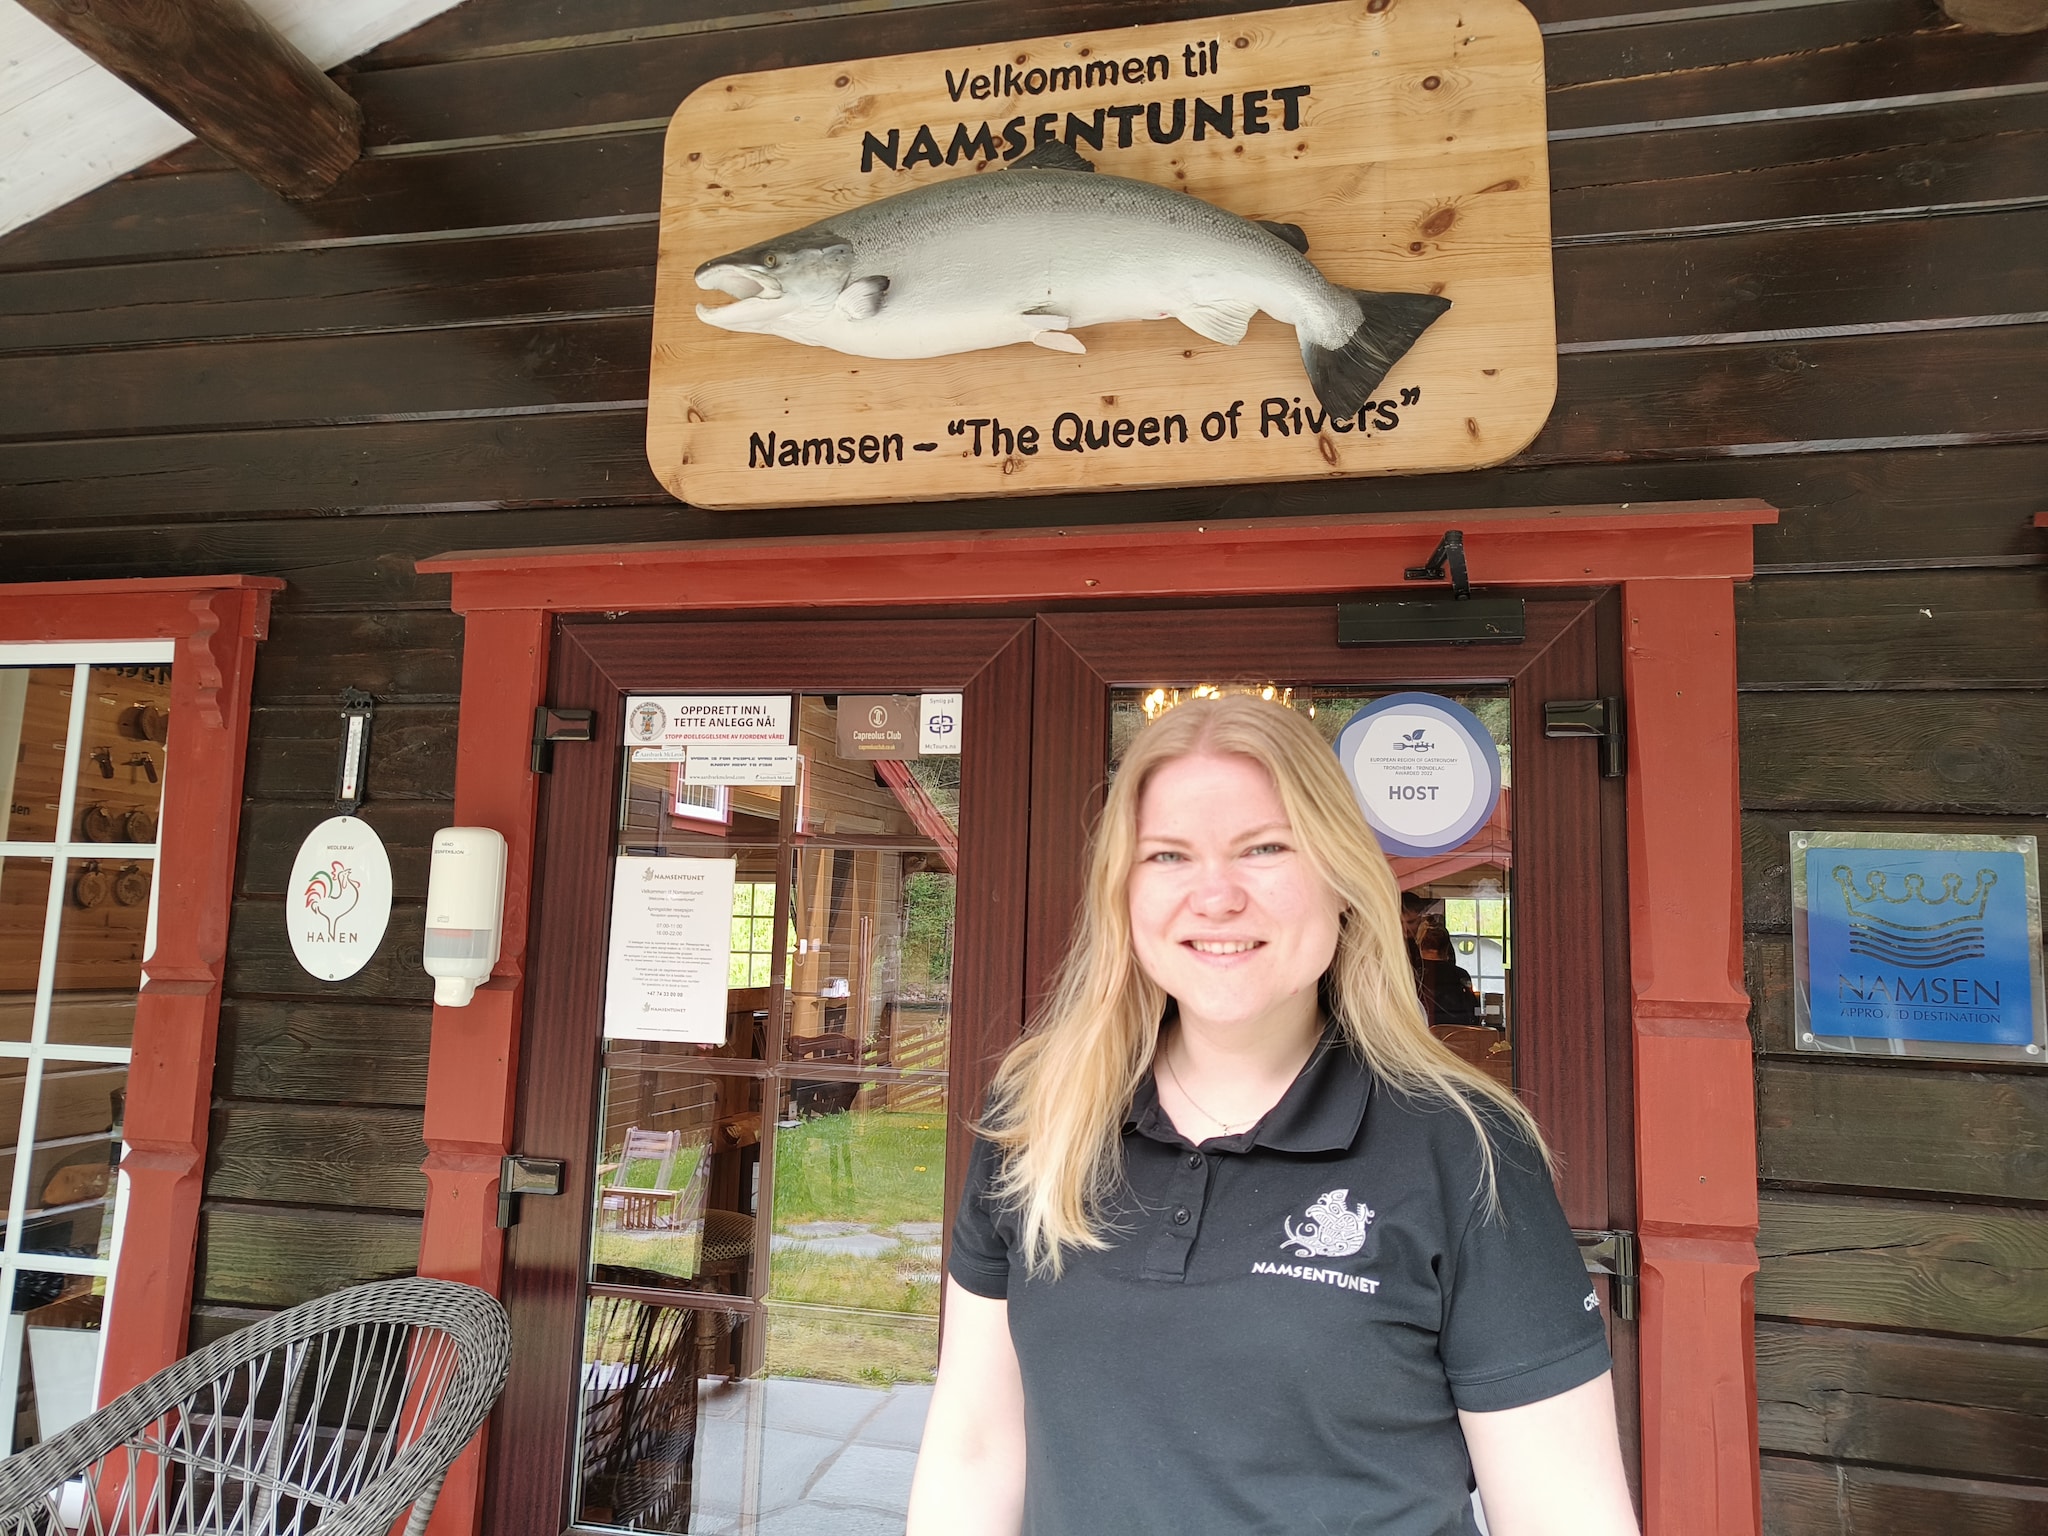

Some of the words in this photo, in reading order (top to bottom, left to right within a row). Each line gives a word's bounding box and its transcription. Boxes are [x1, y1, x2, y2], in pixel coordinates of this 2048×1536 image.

[945, 53, 1170, 102] Velkommen
[1183, 38, 1219, 78] til
[860, 85, 1312, 172] NAMSENTUNET
[748, 431, 904, 468] Namsen
[1052, 412, 1188, 453] Queen
[1200, 400, 1245, 442] of
[681, 706, 738, 715] OPPDRETT
[741, 706, 760, 715] INN
[763, 706, 766, 714] I
[674, 718, 706, 727] TETTE
[709, 718, 753, 727] ANLEGG
[756, 715, 776, 727] NÅ!
[853, 731, 885, 741] Capreolus
[886, 731, 901, 740] Club
[1389, 786, 1439, 800] HOST
[306, 931, 358, 944] HANEN
[1838, 973, 2001, 1006] NAMSEN
[1840, 1007, 1909, 1020] APPROD
[1913, 1011, 2001, 1024] DESTINATION
[1251, 1262, 1380, 1294] NAMSENTUNET
